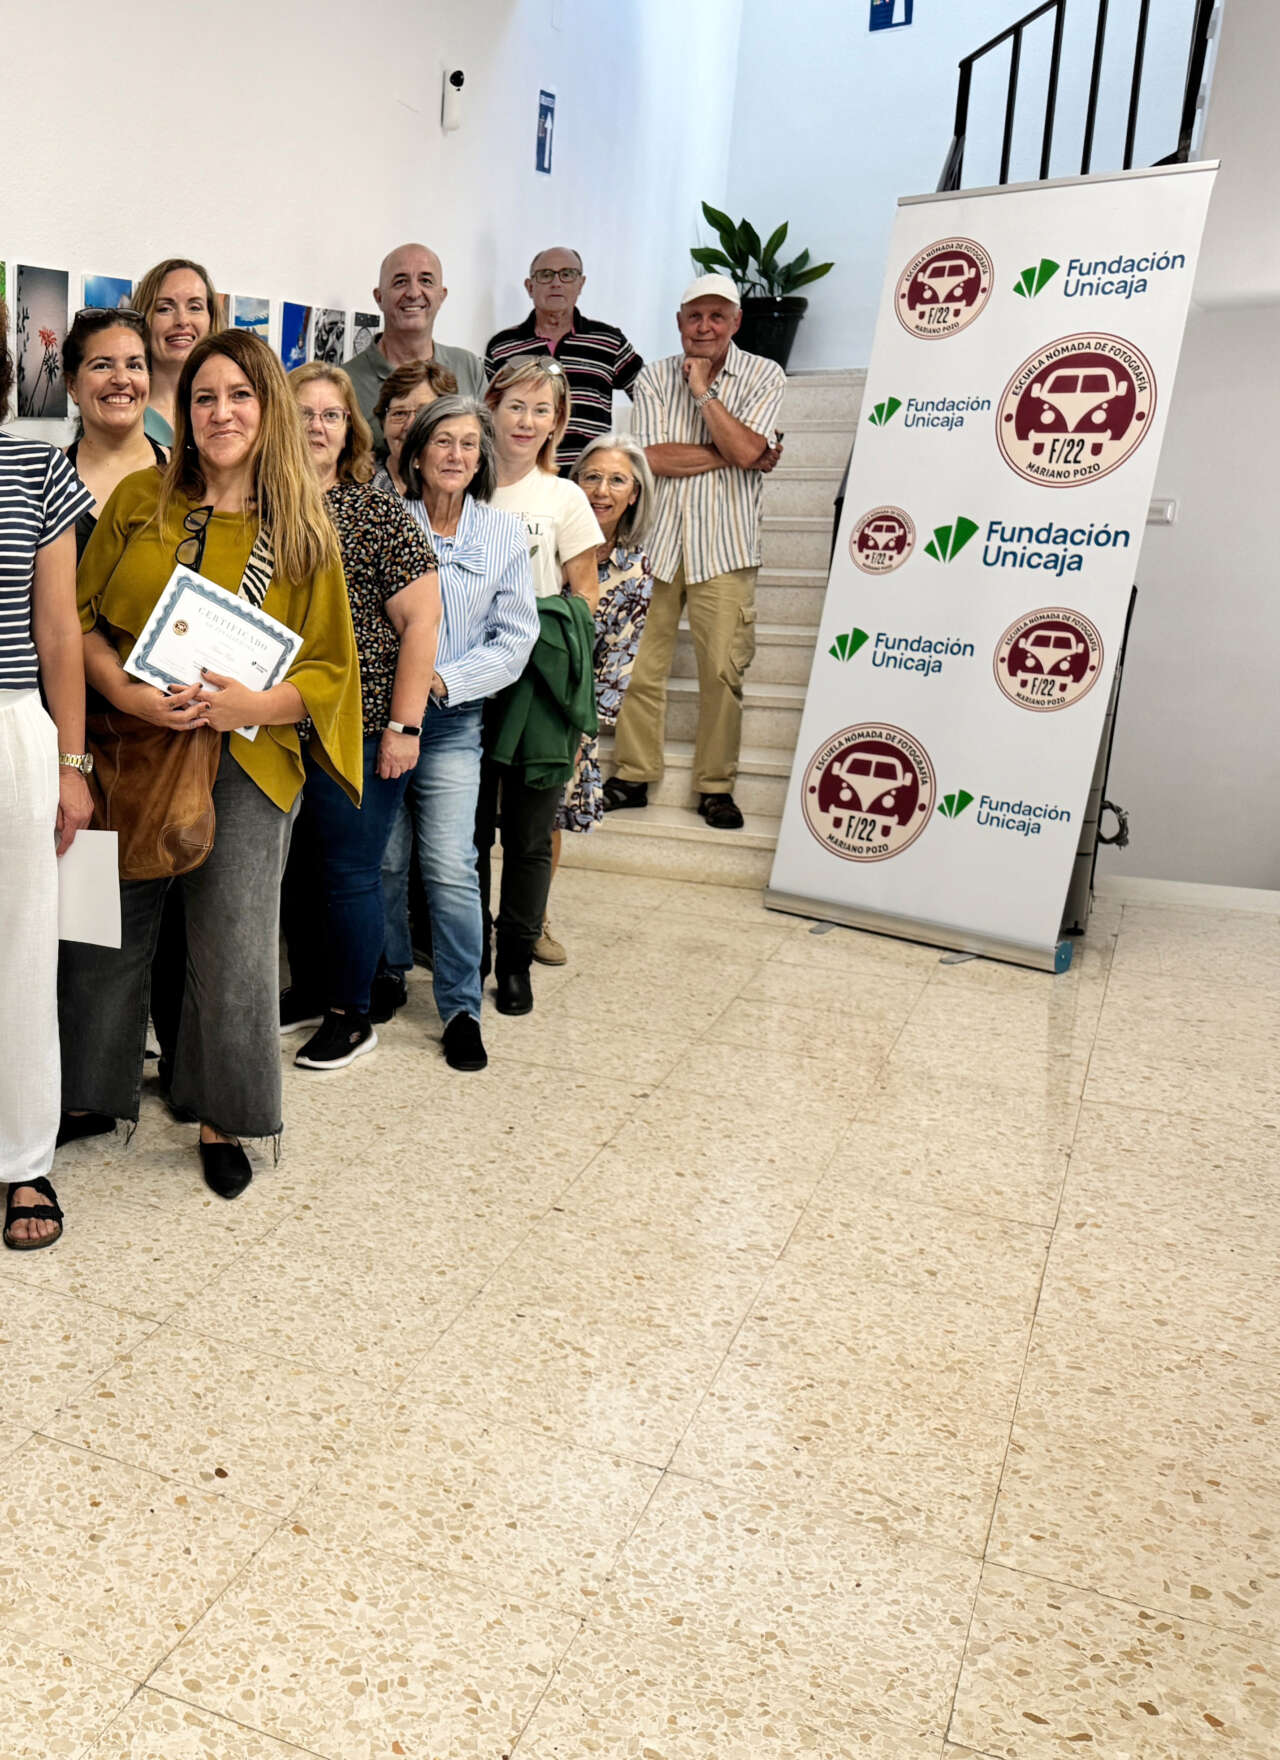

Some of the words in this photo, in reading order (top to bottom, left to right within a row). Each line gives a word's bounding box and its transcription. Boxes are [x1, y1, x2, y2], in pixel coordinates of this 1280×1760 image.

[1067, 251, 1185, 277] Fundación
[1063, 275, 1148, 299] Unicaja
[928, 306, 950, 325] F/22
[1012, 359, 1045, 396] ESCUELA
[1045, 341, 1092, 362] NÓMADA
[1094, 341, 1109, 352] DE
[1108, 345, 1148, 393] FOTOGRAFÍA
[907, 396, 991, 412] Fundación
[904, 412, 964, 431] Unicaja
[1048, 438, 1085, 464] F/22
[1026, 462, 1071, 479] MARIANO
[1073, 463, 1101, 478] POZO
[986, 521, 1130, 547] Fundación
[982, 545, 1083, 577] Unicaja
[875, 633, 975, 657] Fundación
[872, 650, 942, 677] Unicaja
[1030, 677, 1055, 697] F/22
[815, 740, 844, 771] ESCUELA
[885, 733, 897, 742] DE
[980, 795, 1071, 822] Fundación
[845, 815, 876, 842] F/22
[976, 810, 1041, 836] Unicaja
[826, 834, 864, 854] MARIANO
[865, 843, 889, 854] POZO
